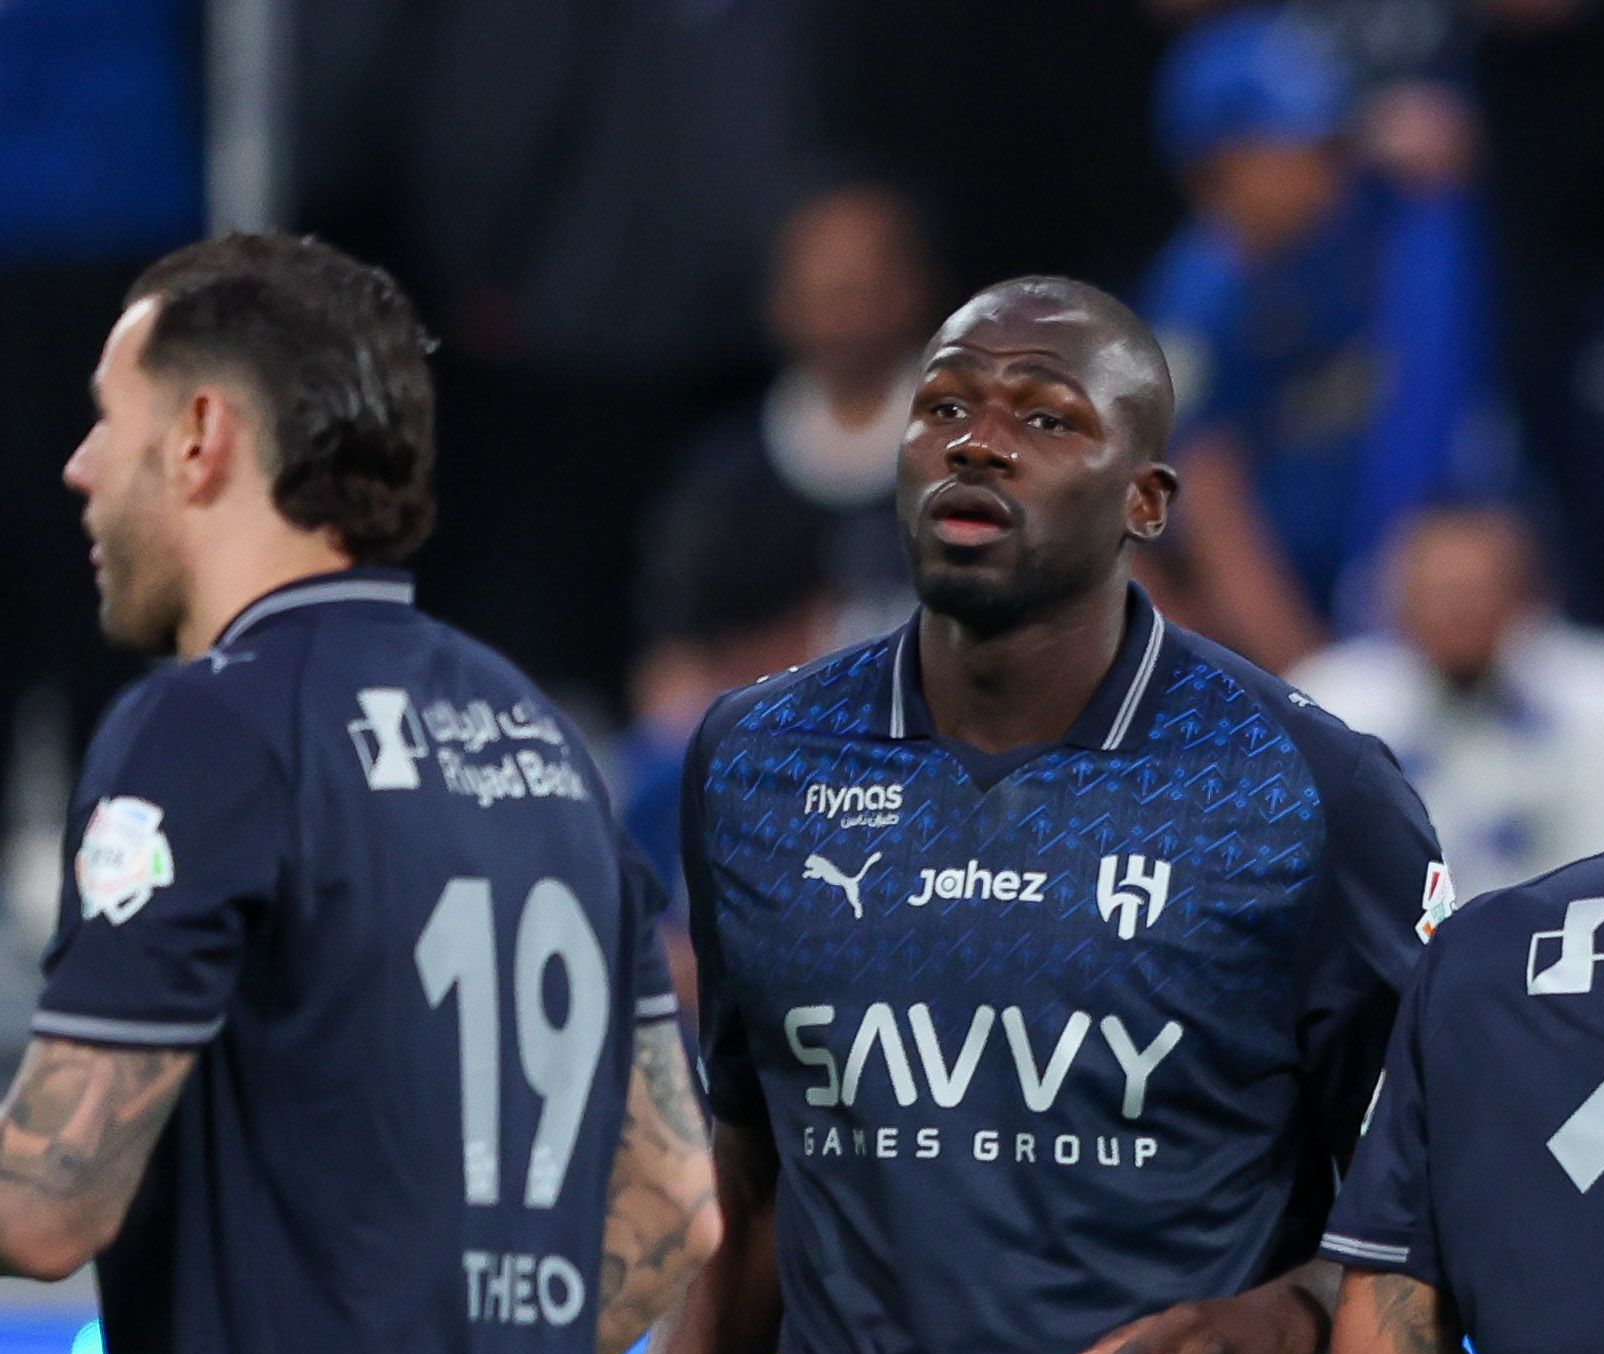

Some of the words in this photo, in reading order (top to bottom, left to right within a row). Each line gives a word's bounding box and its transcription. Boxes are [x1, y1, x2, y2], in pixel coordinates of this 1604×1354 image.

[804, 783, 903, 819] flynas
[907, 859, 1048, 907] jahez
[414, 877, 610, 1208] 19
[784, 1001, 1184, 1120] SAVVY
[803, 1127, 942, 1160] GAMES
[972, 1129, 1159, 1169] GROUP
[461, 1250, 587, 1326] THEO
